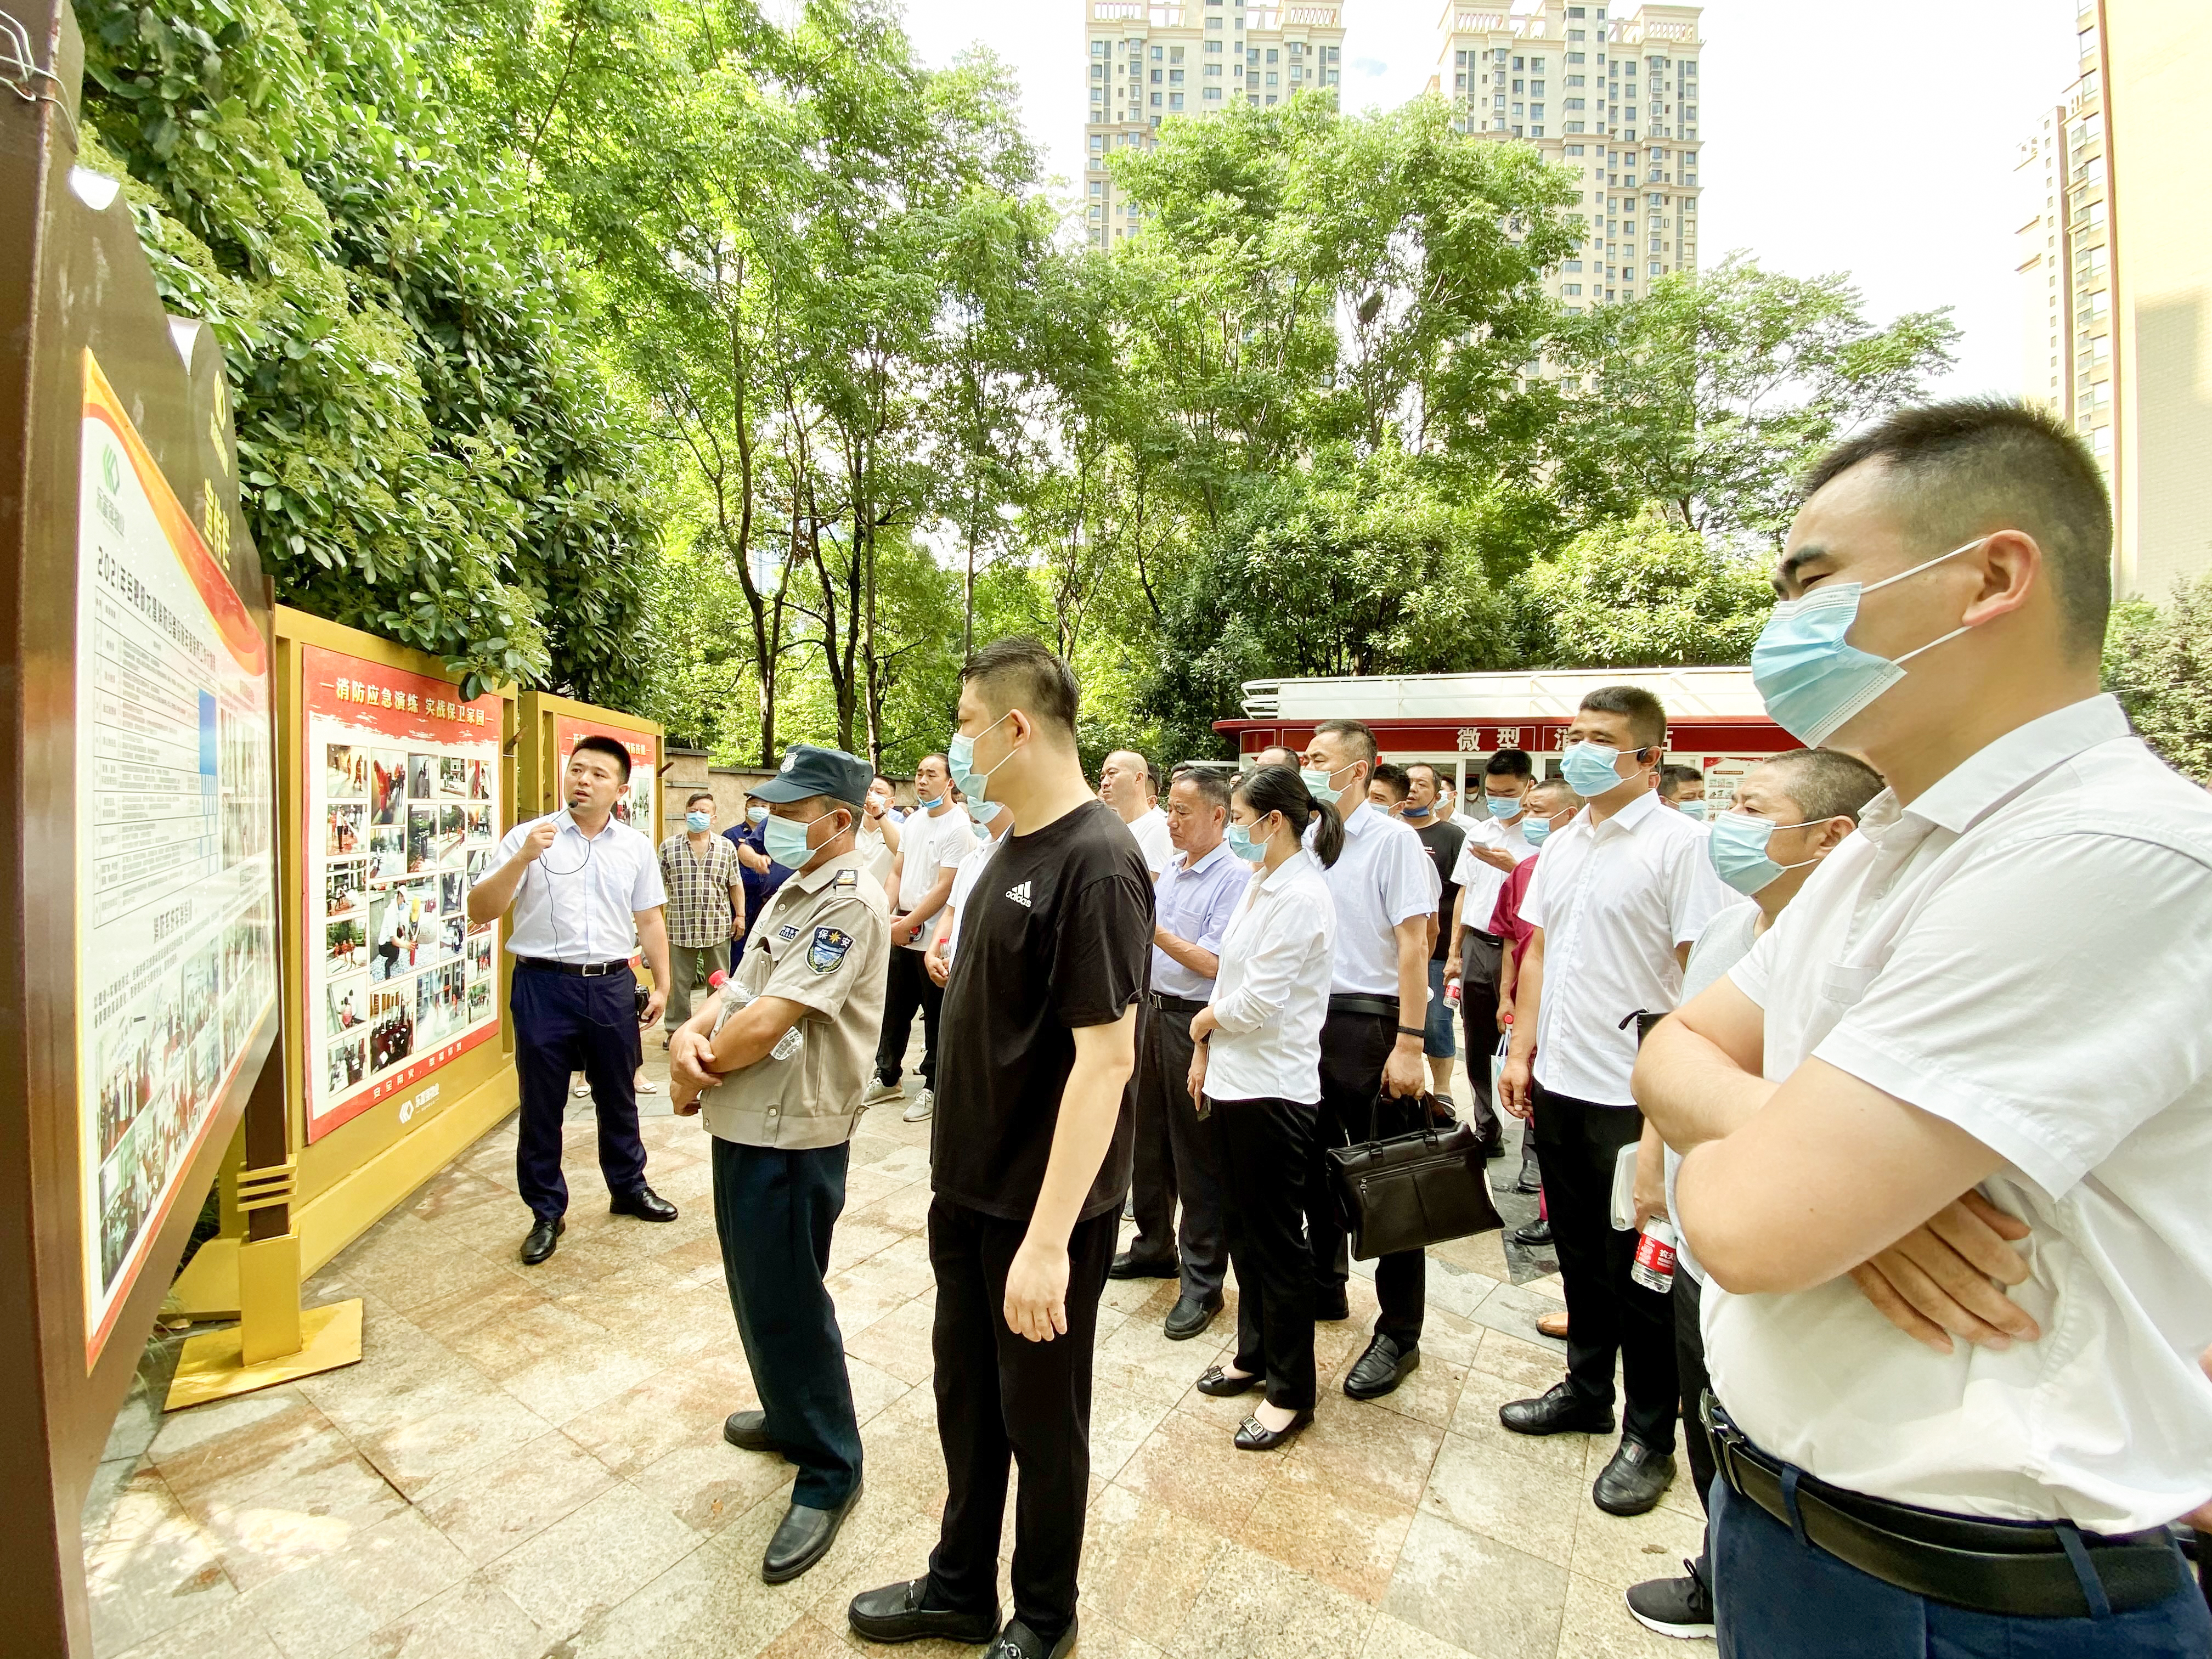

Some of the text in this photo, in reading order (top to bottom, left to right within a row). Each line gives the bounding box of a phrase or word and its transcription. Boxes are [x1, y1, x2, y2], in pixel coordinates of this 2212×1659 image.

[336, 677, 484, 727] 消防应急演练 实战保卫家园
[1005, 890, 1032, 907] adidas
